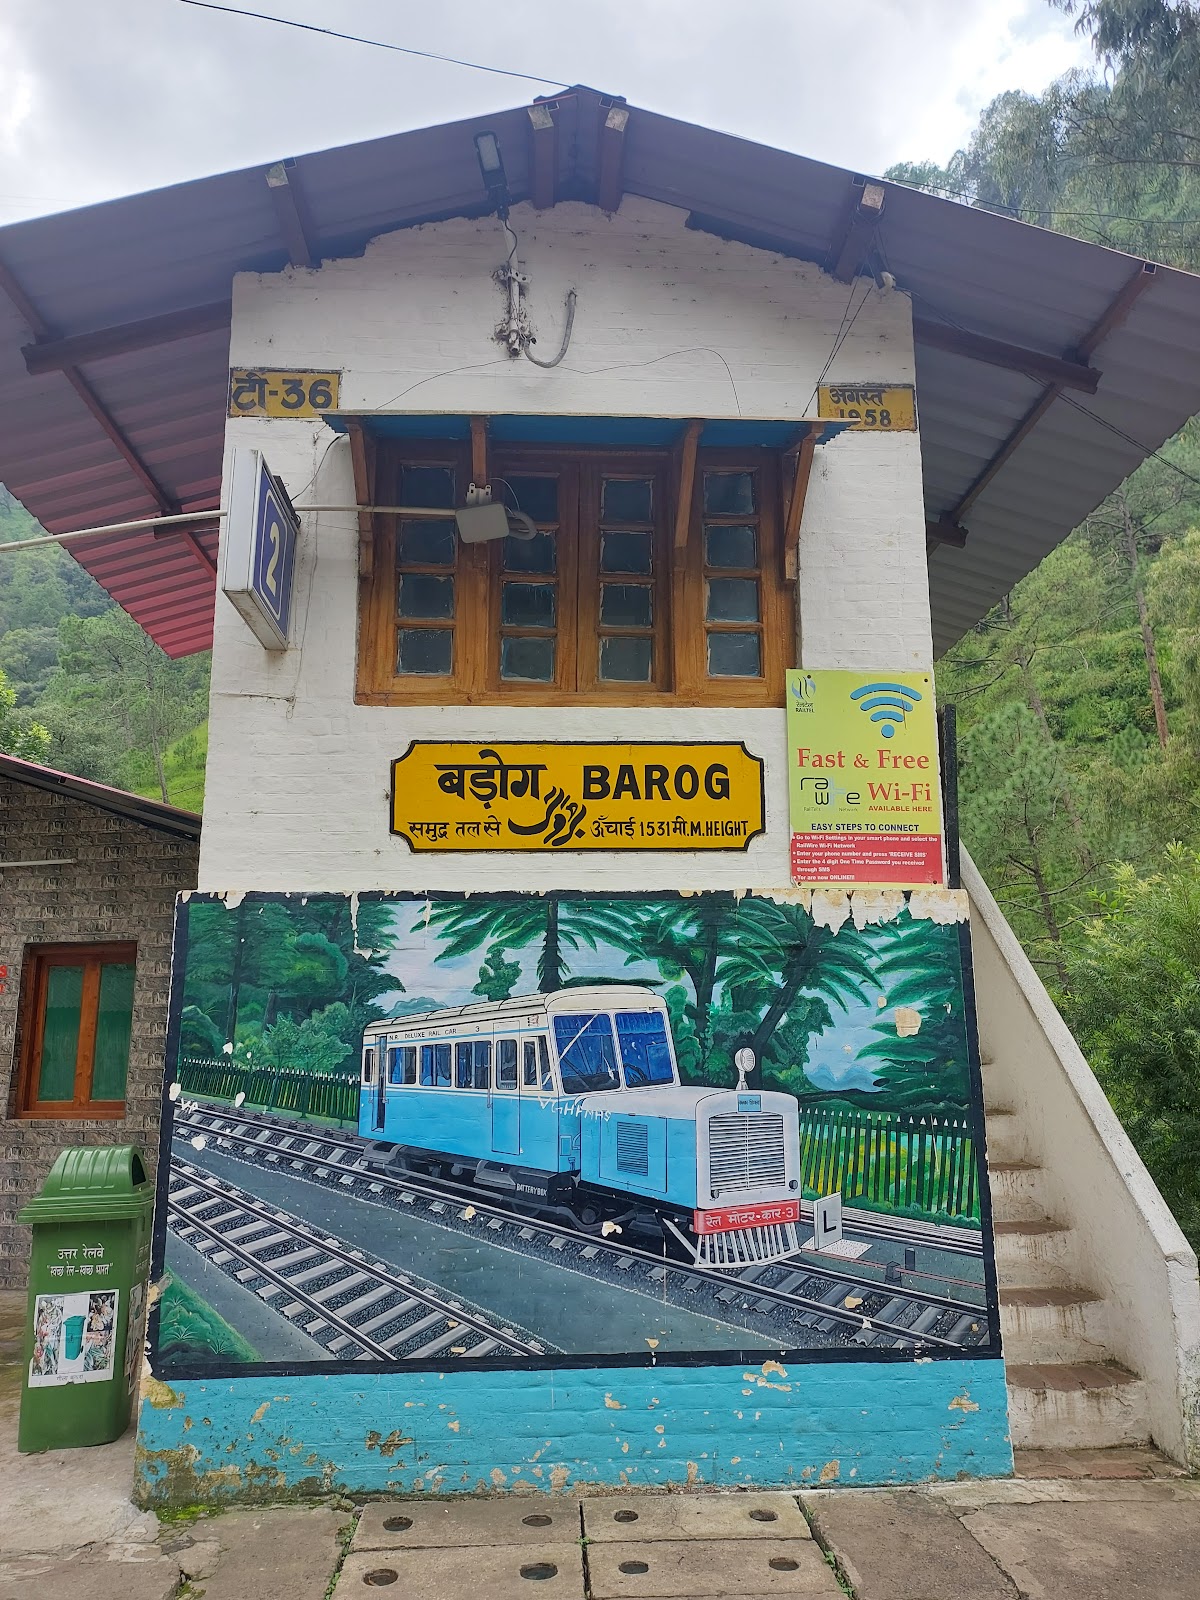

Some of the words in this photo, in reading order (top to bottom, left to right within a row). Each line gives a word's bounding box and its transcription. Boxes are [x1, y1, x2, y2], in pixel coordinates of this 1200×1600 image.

[232, 371, 333, 411] टी-36
[265, 521, 280, 598] 2
[797, 747, 846, 768] Fast
[853, 753, 869, 768] &
[876, 749, 930, 769] Free
[433, 748, 549, 810] बड़ोग
[582, 763, 730, 801] BAROG
[867, 782, 932, 803] Wi-Fi
[407, 820, 450, 842] समुद्र
[455, 820, 480, 839] तल
[483, 814, 502, 838] से
[811, 823, 833, 831] EASY
[835, 823, 862, 831] STEPS
[864, 823, 876, 831] TO
[878, 823, 920, 832] CONNECT
[404, 1031, 426, 1040] DELUXE
[428, 1029, 442, 1038] RAIL
[444, 1028, 458, 1036] CAR
[475, 1025, 481, 1033] 3
[705, 1214, 721, 1227] रेल
[823, 1210, 837, 1233] L
[57, 1248, 79, 1259] उत्तर
[82, 1242, 105, 1259] रेलवे
